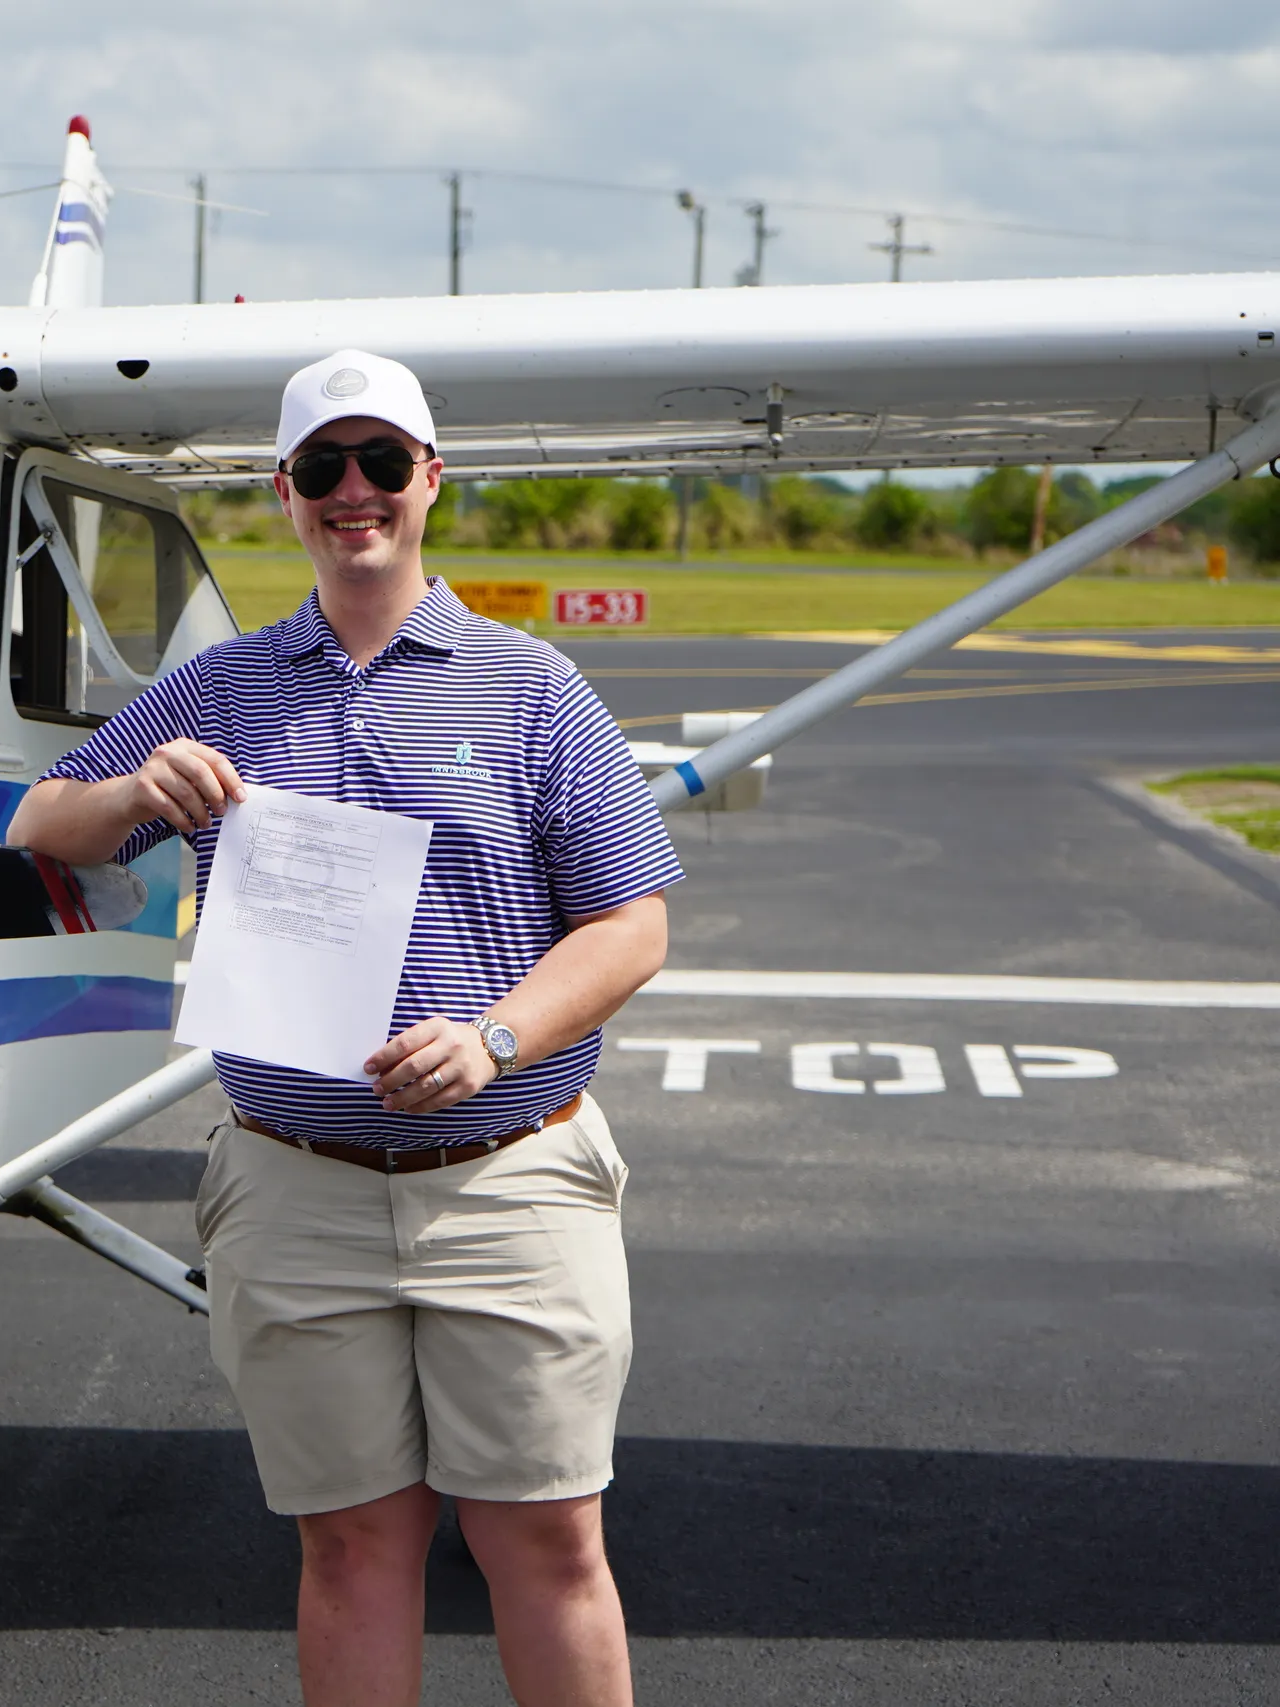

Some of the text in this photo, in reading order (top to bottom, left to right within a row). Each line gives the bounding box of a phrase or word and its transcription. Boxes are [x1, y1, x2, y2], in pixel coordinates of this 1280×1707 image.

[564, 592, 638, 624] 15-33
[431, 766, 492, 778] INNISBROOK
[616, 1038, 1120, 1098] TOP
